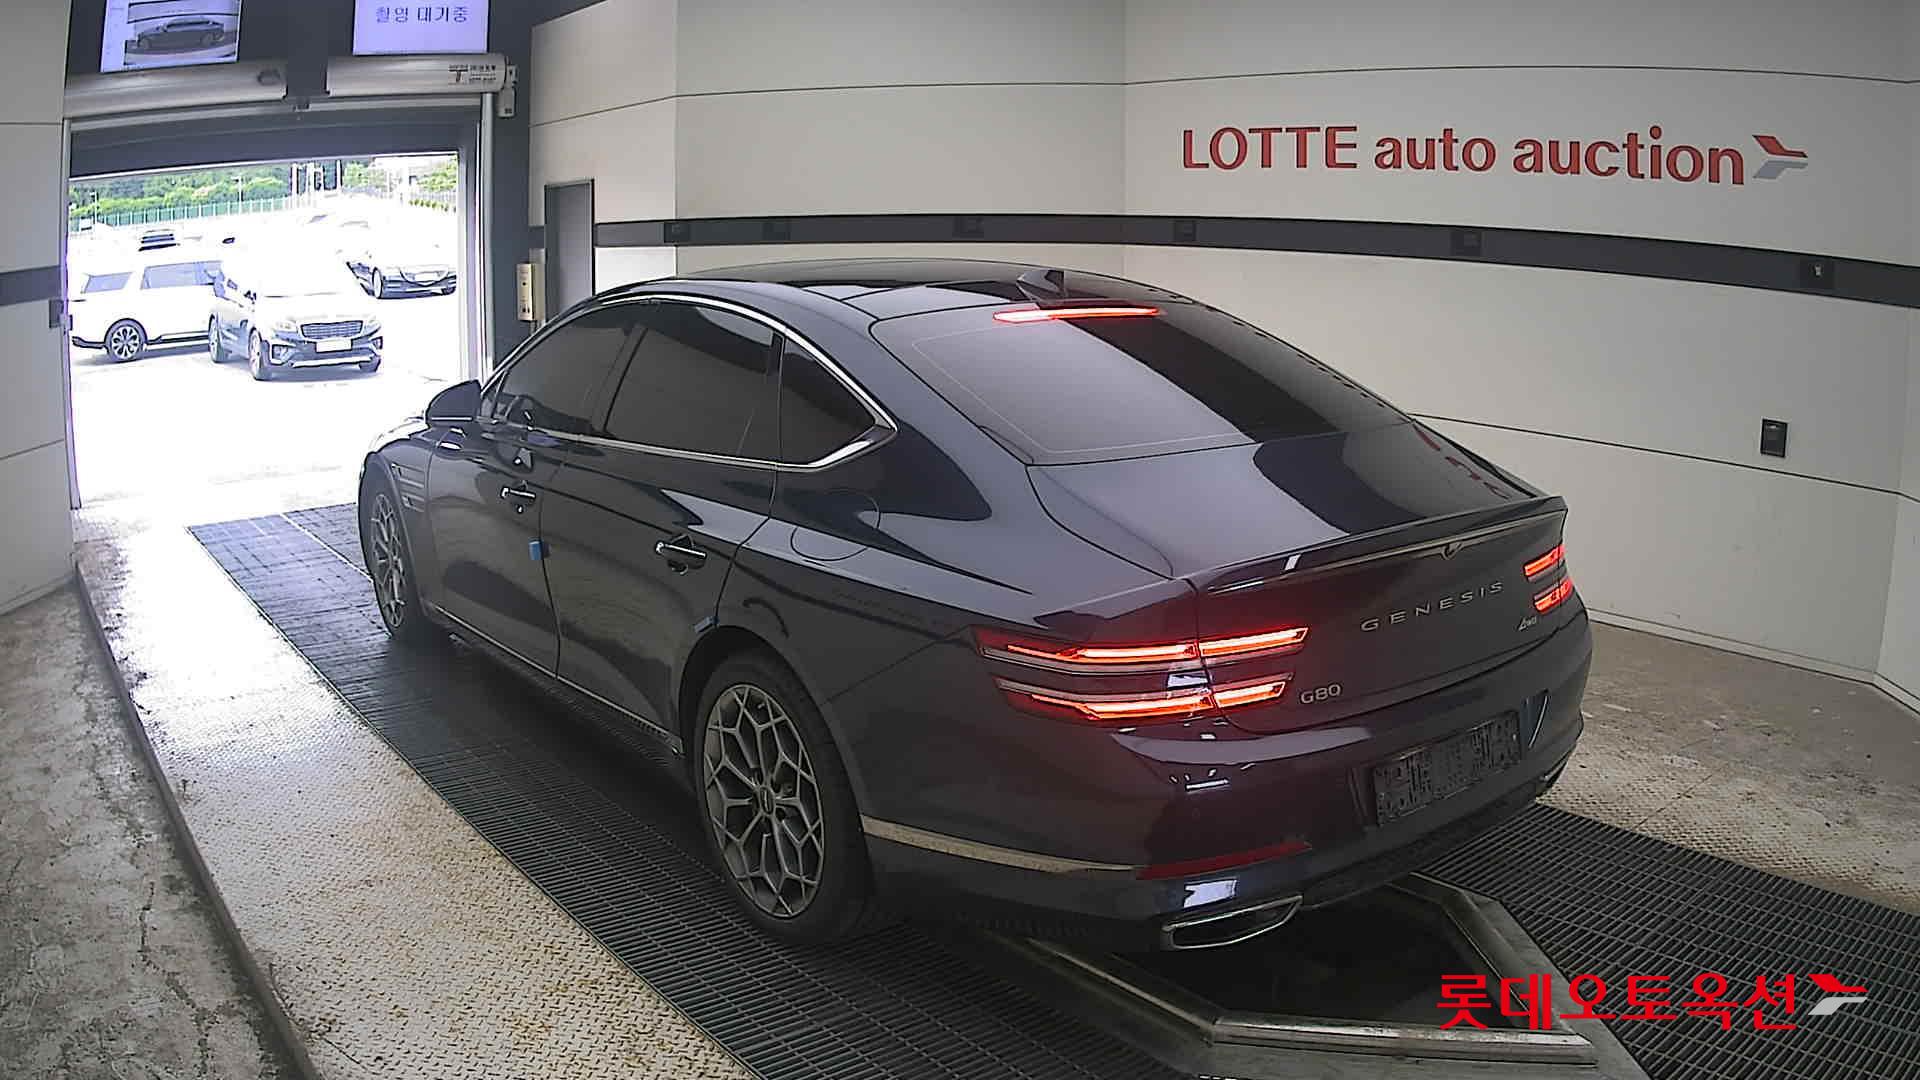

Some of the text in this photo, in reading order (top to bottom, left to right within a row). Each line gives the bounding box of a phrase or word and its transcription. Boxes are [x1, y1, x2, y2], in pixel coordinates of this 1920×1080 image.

[417, 6, 468, 23] 대기중
[1183, 125, 1744, 185] LOTTE auto auction
[1360, 582, 1504, 632] GENESIS
[1300, 683, 1343, 704] G80
